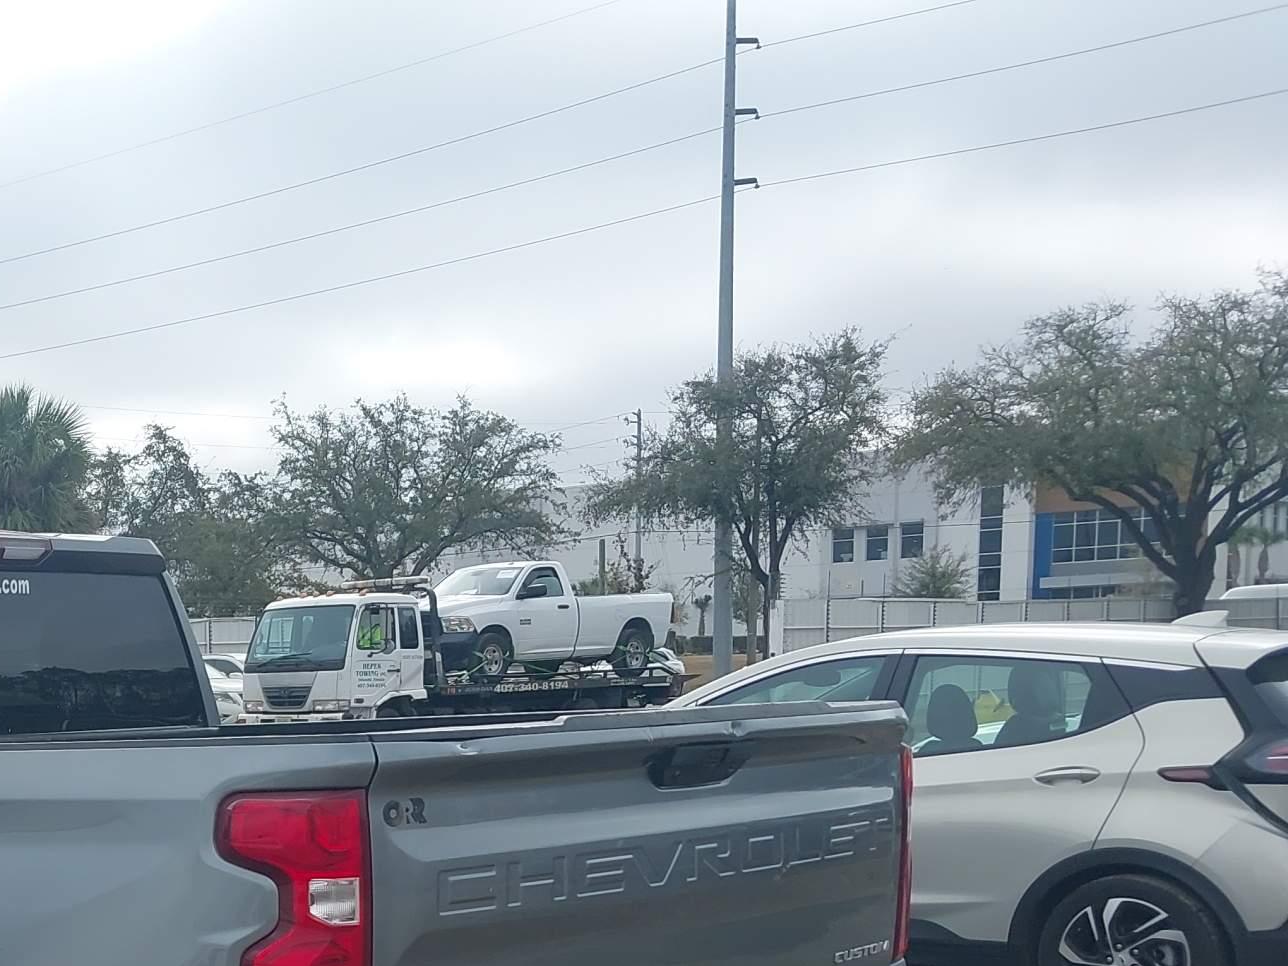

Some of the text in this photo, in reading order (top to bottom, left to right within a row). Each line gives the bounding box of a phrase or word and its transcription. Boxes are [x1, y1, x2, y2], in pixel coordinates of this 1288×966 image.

[493, 681, 569, 693] 407-340-8194
[437, 811, 890, 916] CHEVROLET
[834, 940, 889, 963] CUSTOM
